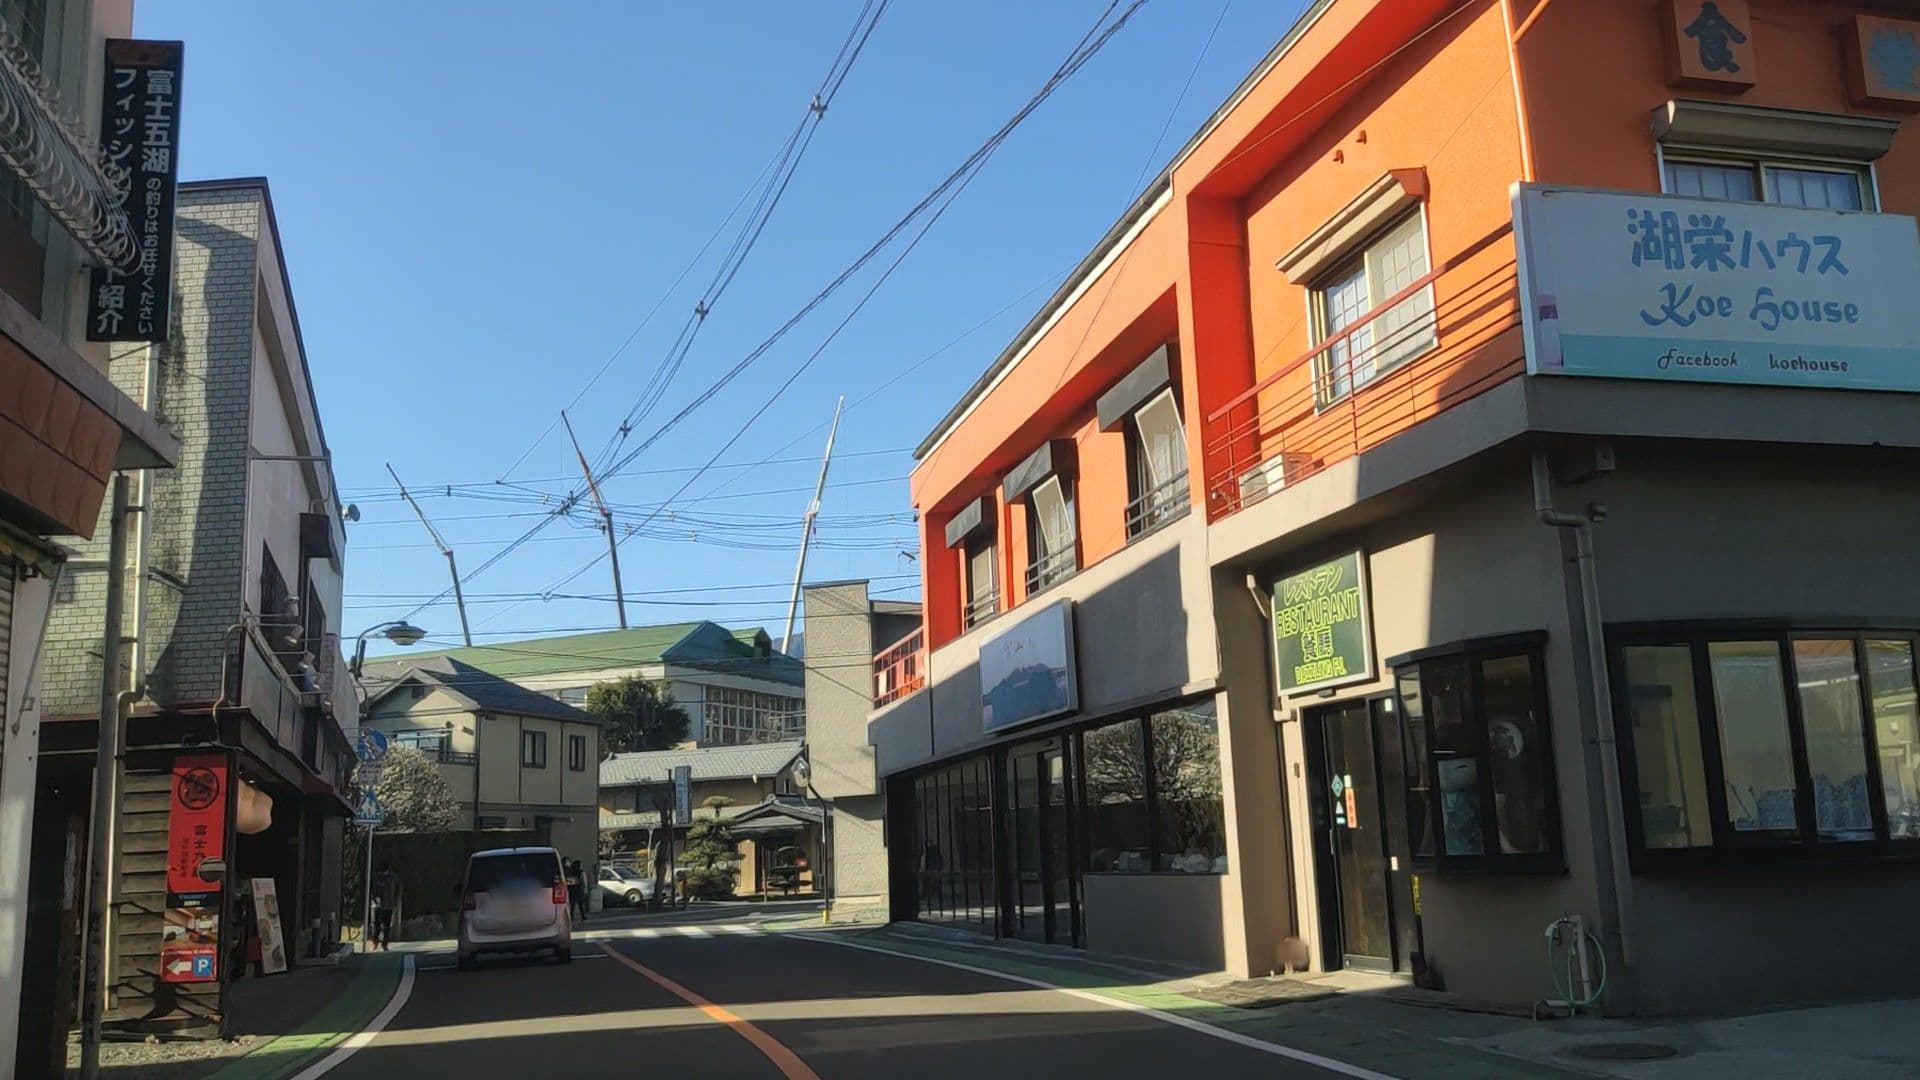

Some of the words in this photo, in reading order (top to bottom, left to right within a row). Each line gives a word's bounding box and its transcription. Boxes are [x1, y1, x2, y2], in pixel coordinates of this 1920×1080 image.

[1626, 208, 1850, 276] 湖栄ハウス
[1639, 282, 1733, 328] Koe
[1749, 286, 1860, 331] House
[1657, 348, 1738, 370] Facebook
[1768, 353, 1849, 373] koehouse
[1283, 565, 1343, 607] レストラン
[1276, 587, 1360, 639] RESTAURANT
[198, 958, 209, 974] P
